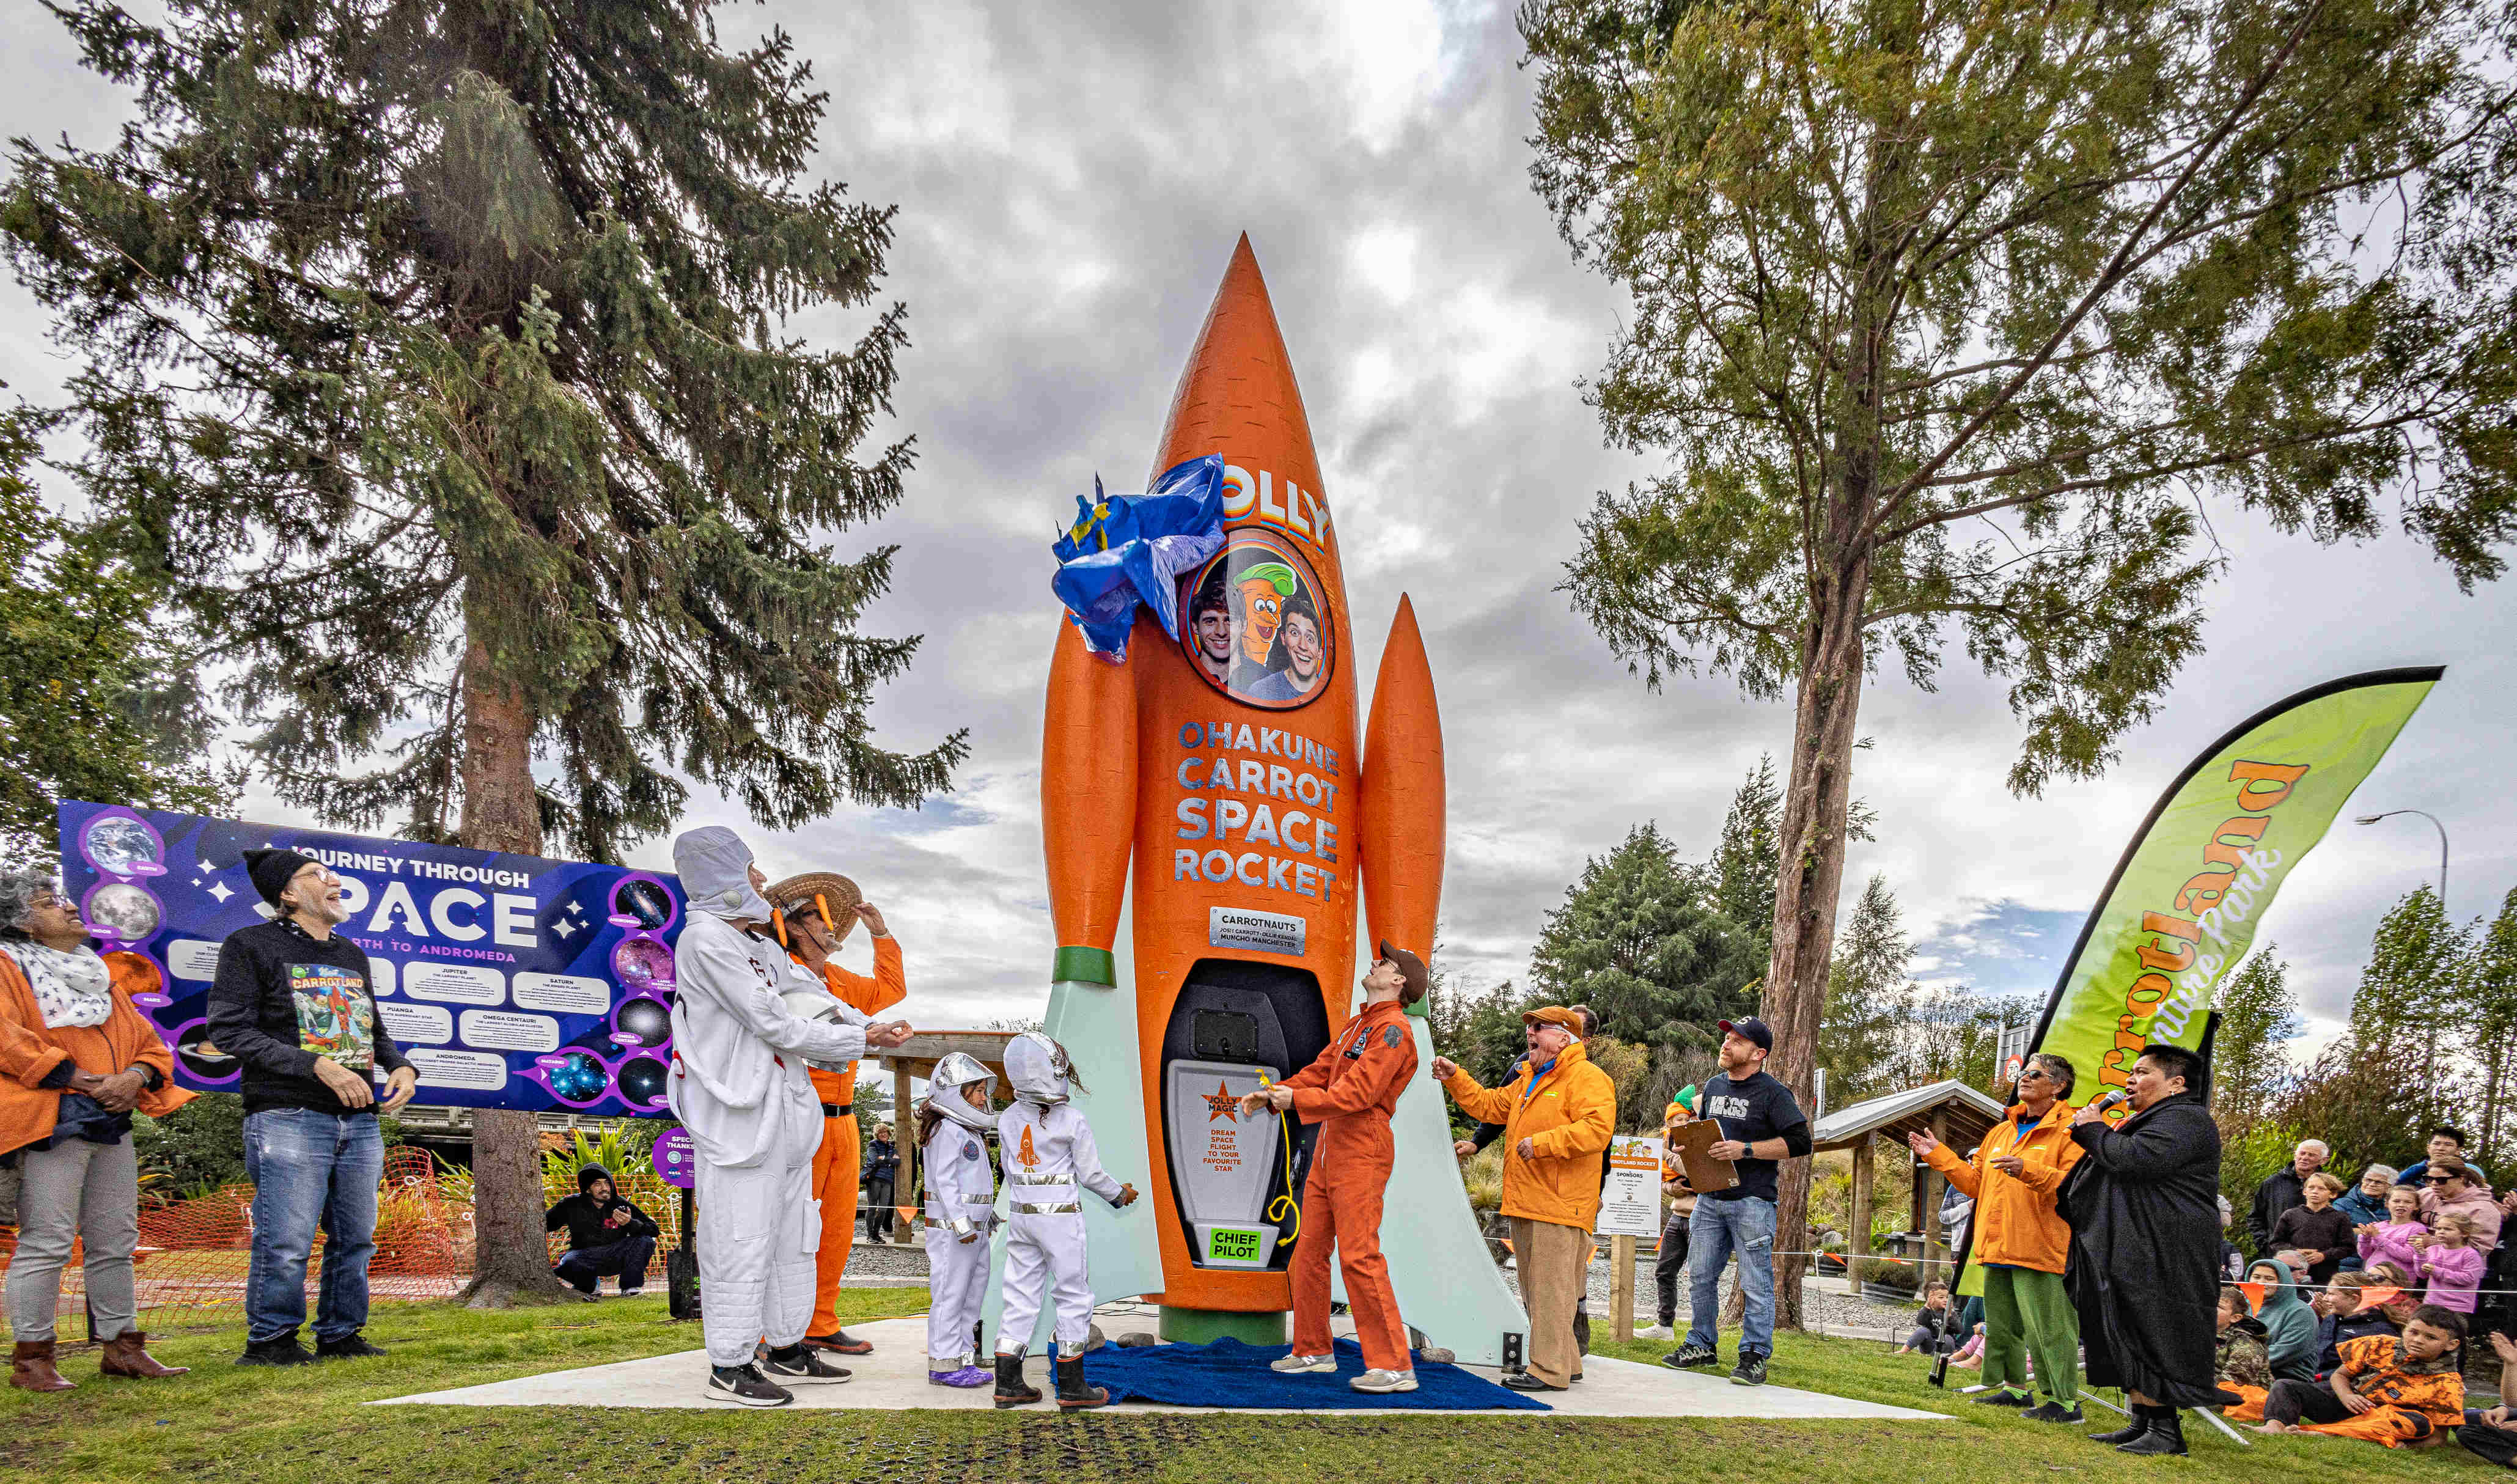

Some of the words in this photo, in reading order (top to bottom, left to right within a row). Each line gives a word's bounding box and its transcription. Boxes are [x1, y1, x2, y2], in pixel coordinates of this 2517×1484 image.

[1222, 465, 1329, 554] OLLY
[1178, 721, 1339, 777] OHAKUNE
[1177, 757, 1339, 814] CARROT
[1176, 797, 1338, 864] SPACE
[292, 845, 404, 873] OURNEY
[409, 860, 530, 889] THROUGH
[1174, 849, 1337, 902] ROCKET
[253, 875, 538, 948] PACE
[2196, 848, 2283, 947] Park
[1220, 933, 1251, 942] MUNCHO
[1252, 937, 1296, 948] MANCHESTER
[1222, 915, 1296, 932] CARROTNAUTS
[351, 938, 383, 949] RTH
[391, 939, 412, 952] TO
[419, 945, 516, 963] ANDROMEDA
[293, 978, 364, 990] CARROTLAND
[1208, 1096, 1238, 1105] JOLLY
[1208, 1104, 1238, 1112] MAGIC
[1214, 1245, 1255, 1258] PILOT
[1215, 1232, 1257, 1245] CHIEF
